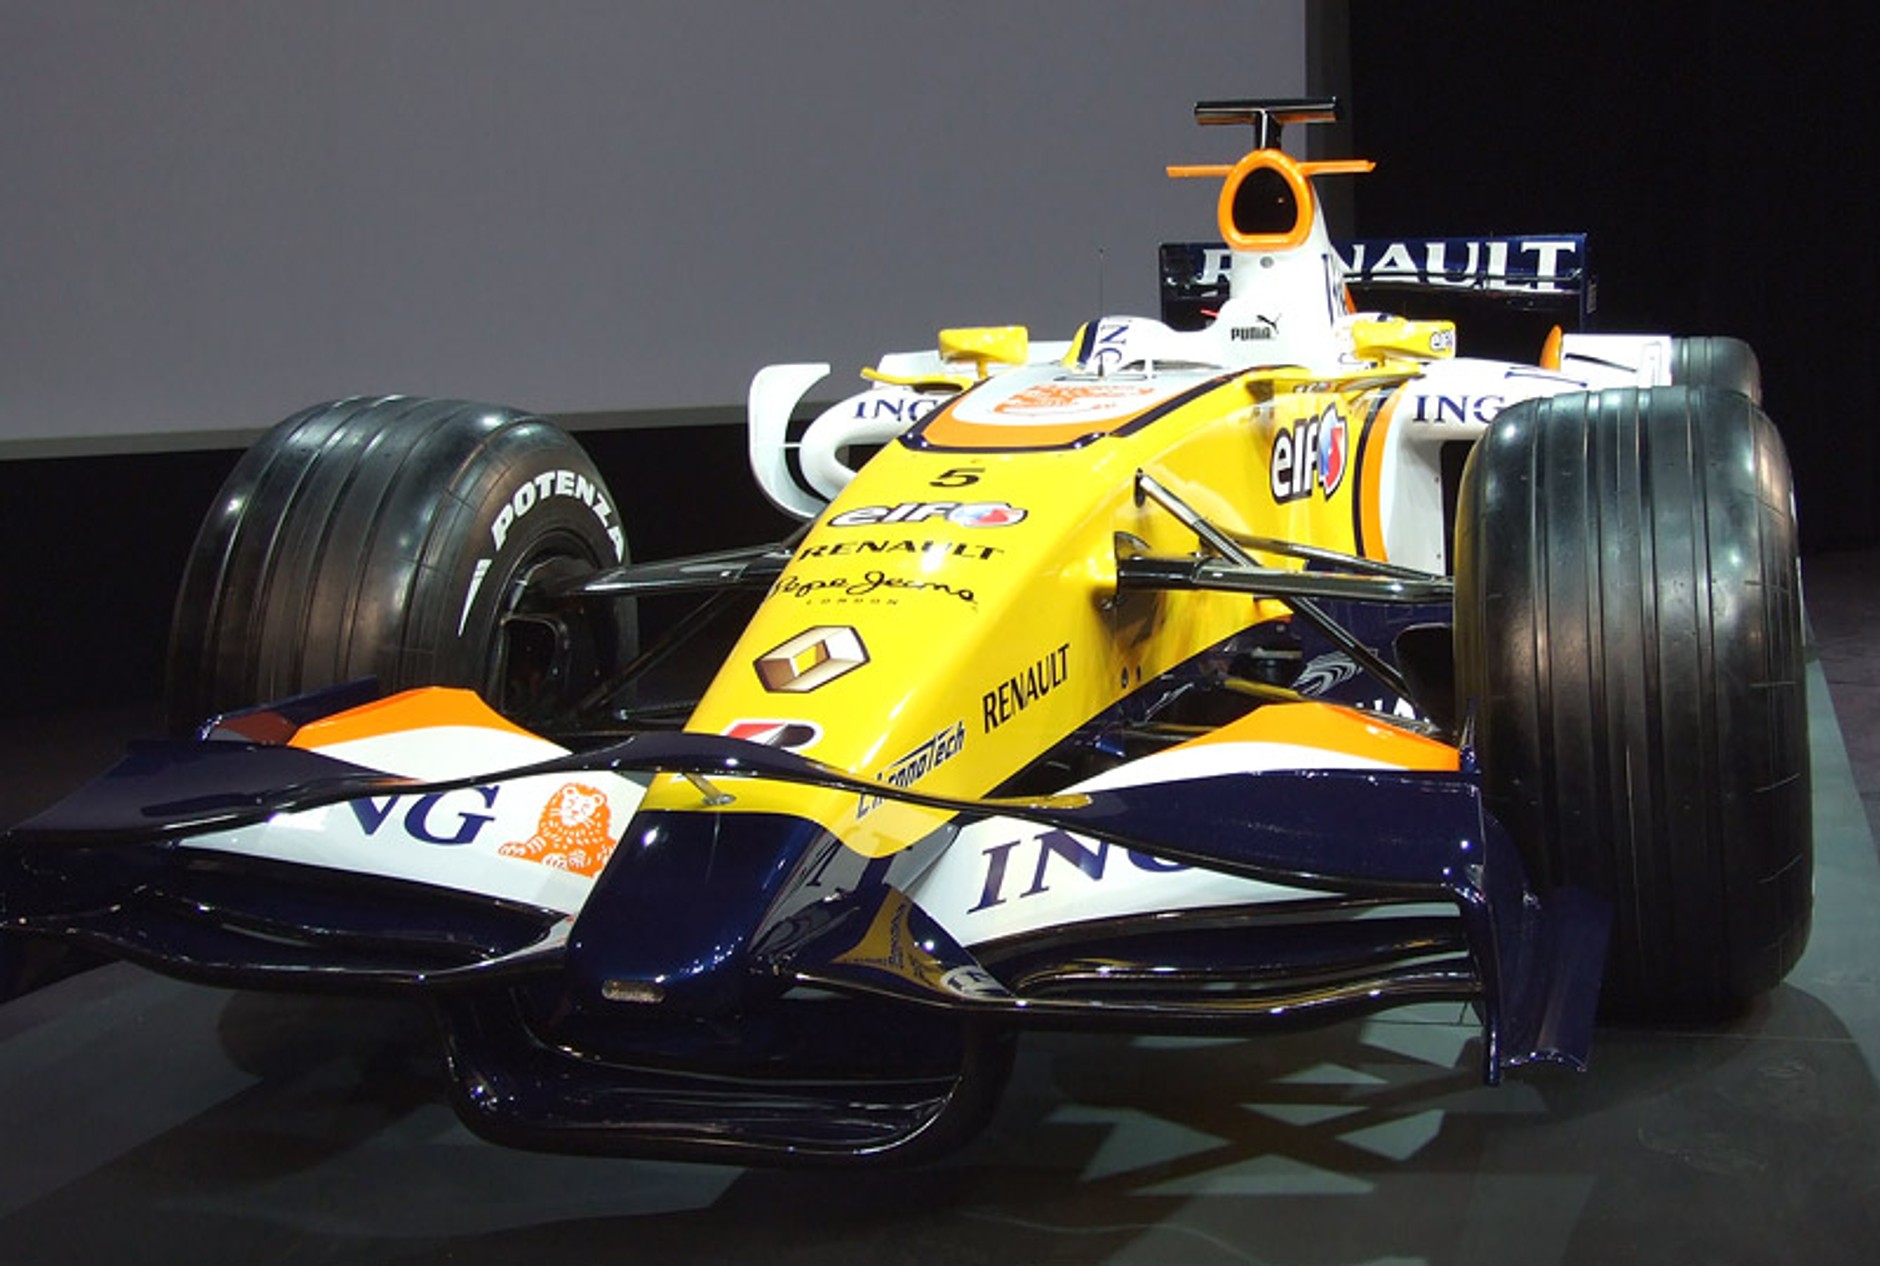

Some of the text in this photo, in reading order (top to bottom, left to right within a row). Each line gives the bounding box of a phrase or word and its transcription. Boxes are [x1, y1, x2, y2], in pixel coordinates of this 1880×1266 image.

[1200, 241, 1577, 293] RNAULT
[1412, 395, 1506, 424] ING
[929, 467, 986, 487] 5
[491, 470, 625, 563] POTENZA
[827, 502, 962, 527] elf
[982, 643, 1070, 734] RENAULT
[350, 785, 500, 845] NG
